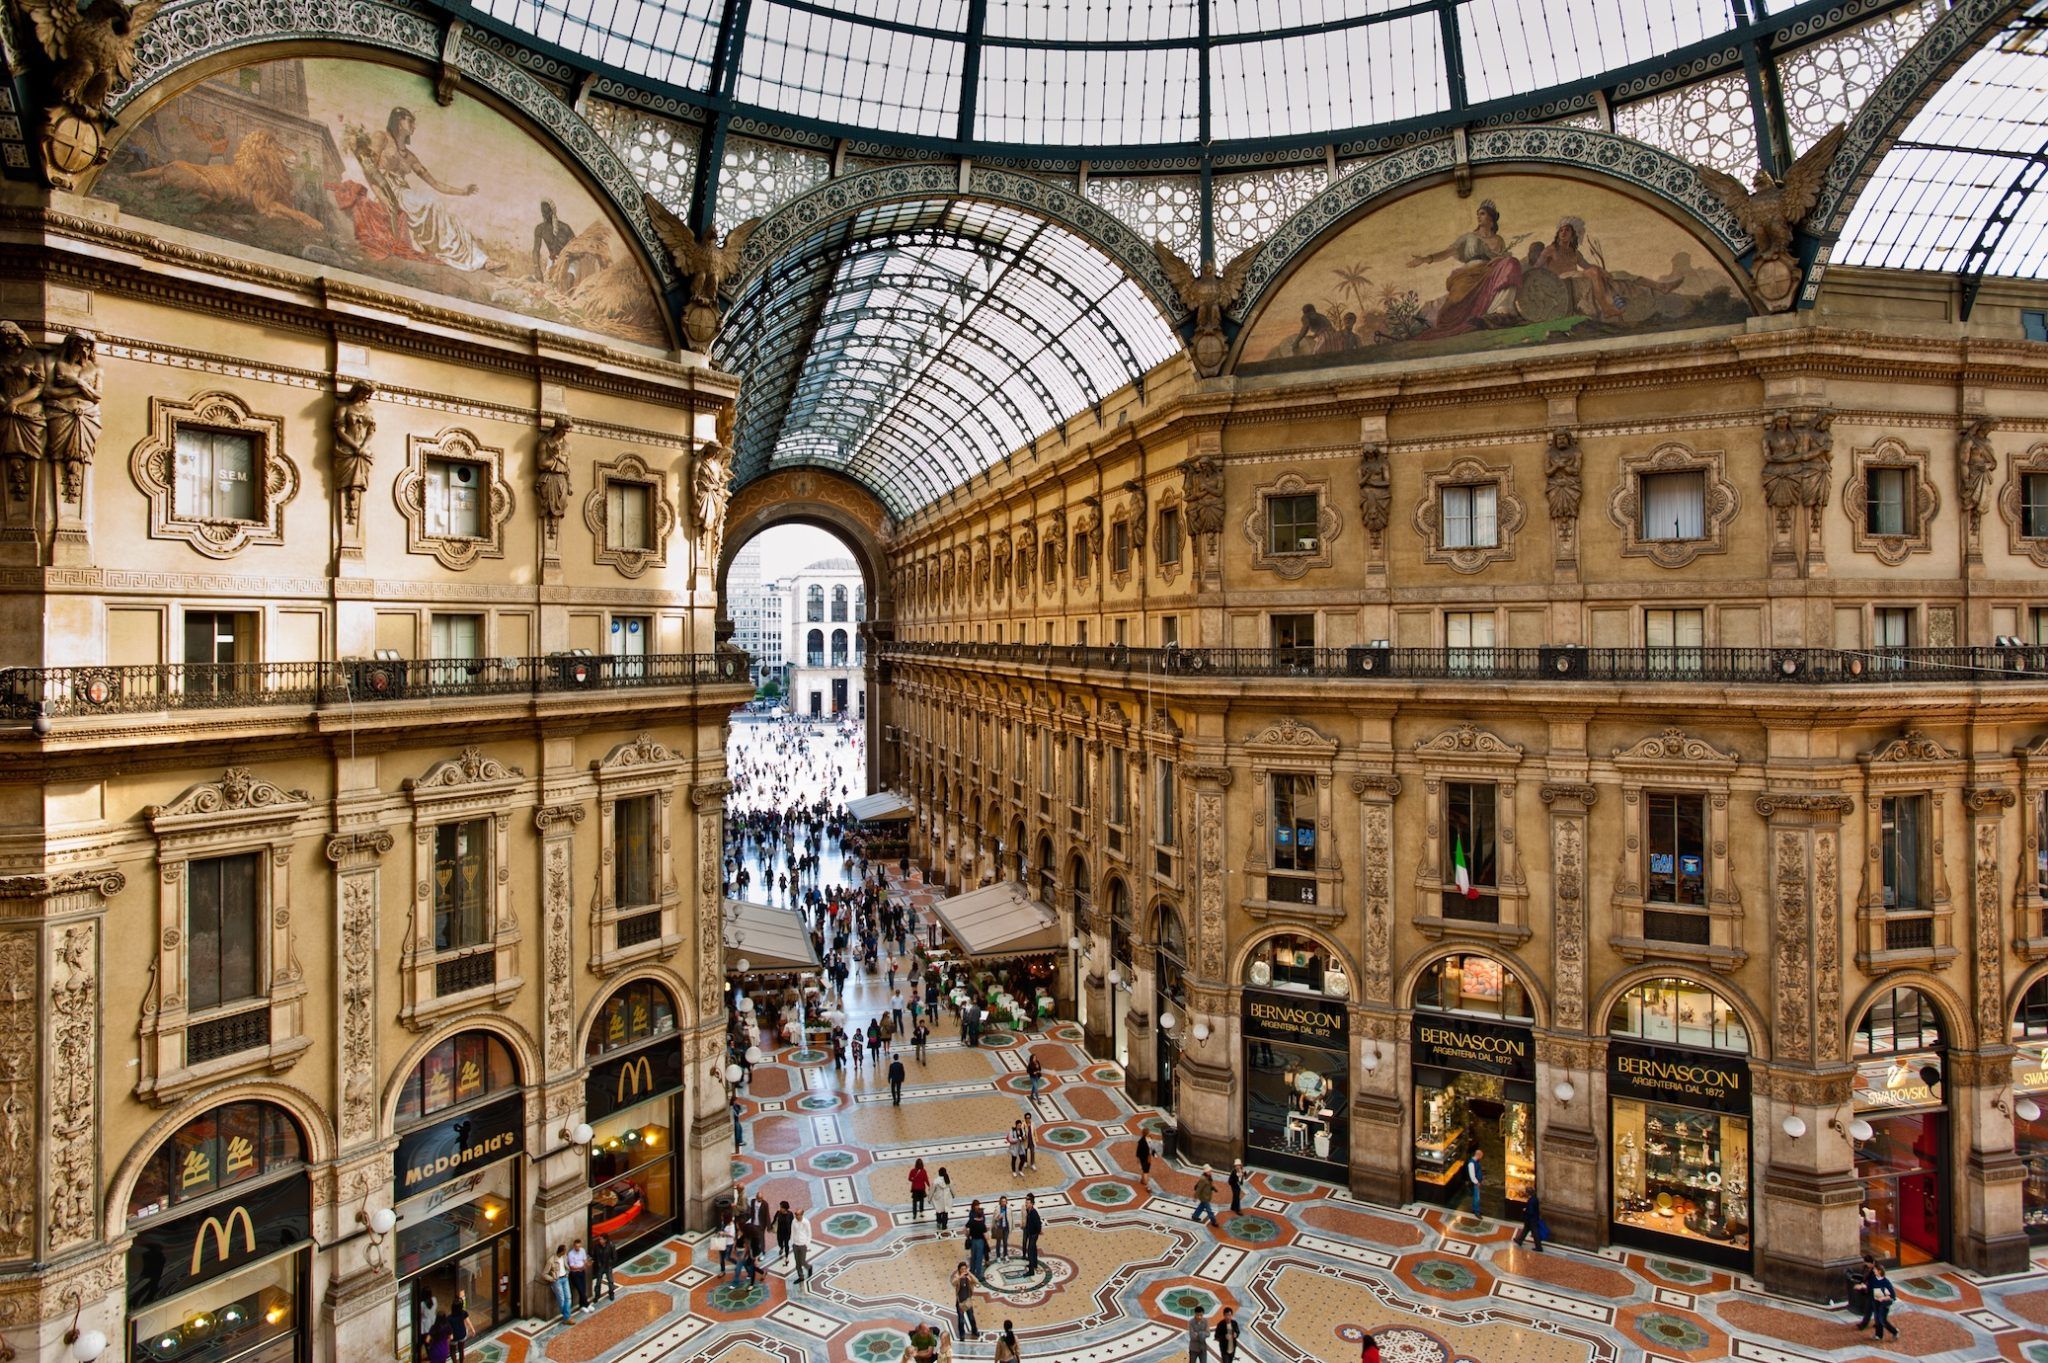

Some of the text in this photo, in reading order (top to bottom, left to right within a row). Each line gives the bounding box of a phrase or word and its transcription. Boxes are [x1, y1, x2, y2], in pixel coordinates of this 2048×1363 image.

[1250, 1002, 1341, 1030] BERNASCONI
[1260, 1019, 1331, 1038] ARGENTERIA DAL 1872
[1421, 1027, 1525, 1057] BERNASCONI
[1432, 1045, 1513, 1066] ARGENTERIA DAL 1872
[1617, 1056, 1739, 1089] BERNASCONI
[1631, 1076, 1725, 1099] ARGENTERIA DAL 1872
[1867, 1086, 1928, 1105] SWAROVSKI
[404, 1131, 514, 1187] McDonald's
